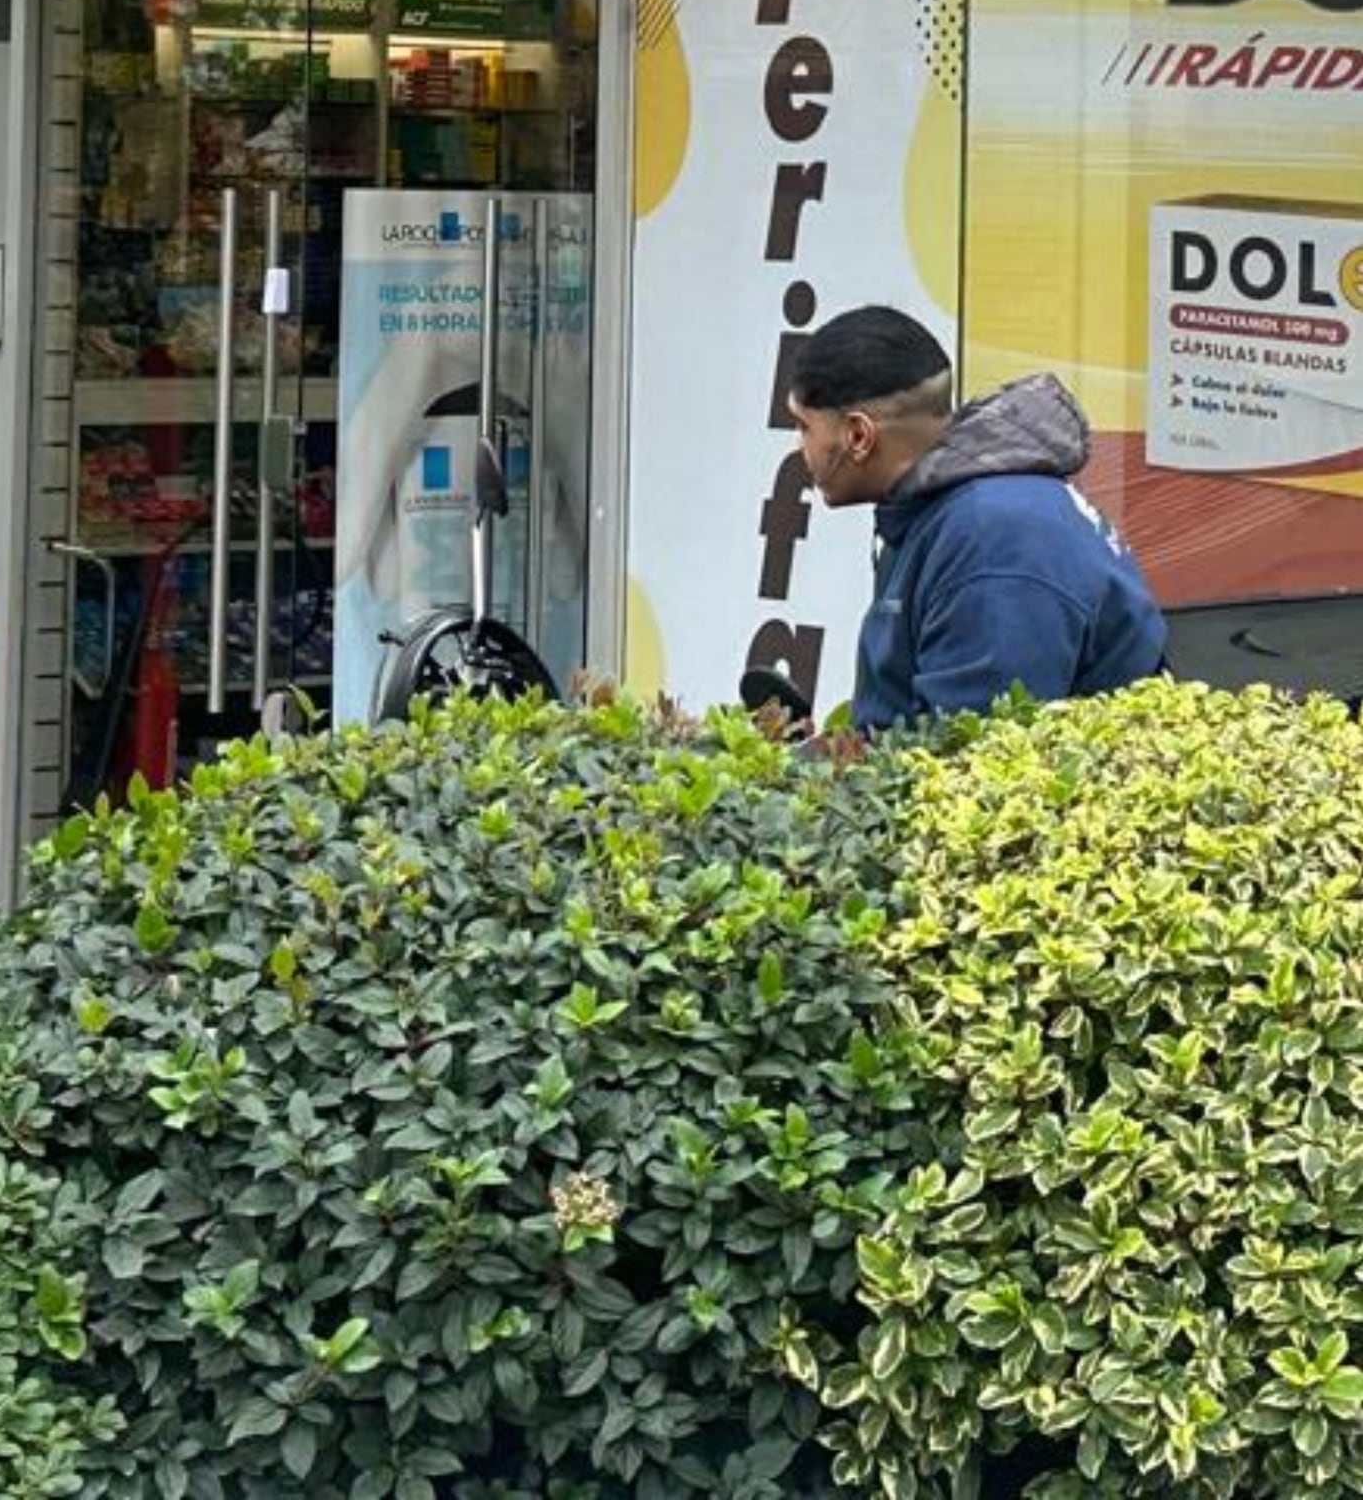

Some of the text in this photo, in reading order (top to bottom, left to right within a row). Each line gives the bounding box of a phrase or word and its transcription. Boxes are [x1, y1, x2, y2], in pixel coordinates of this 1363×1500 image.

[1165, 30, 1363, 92] RÁPID
[1170, 336, 1348, 374] CÁPSULAS BLANDAS
